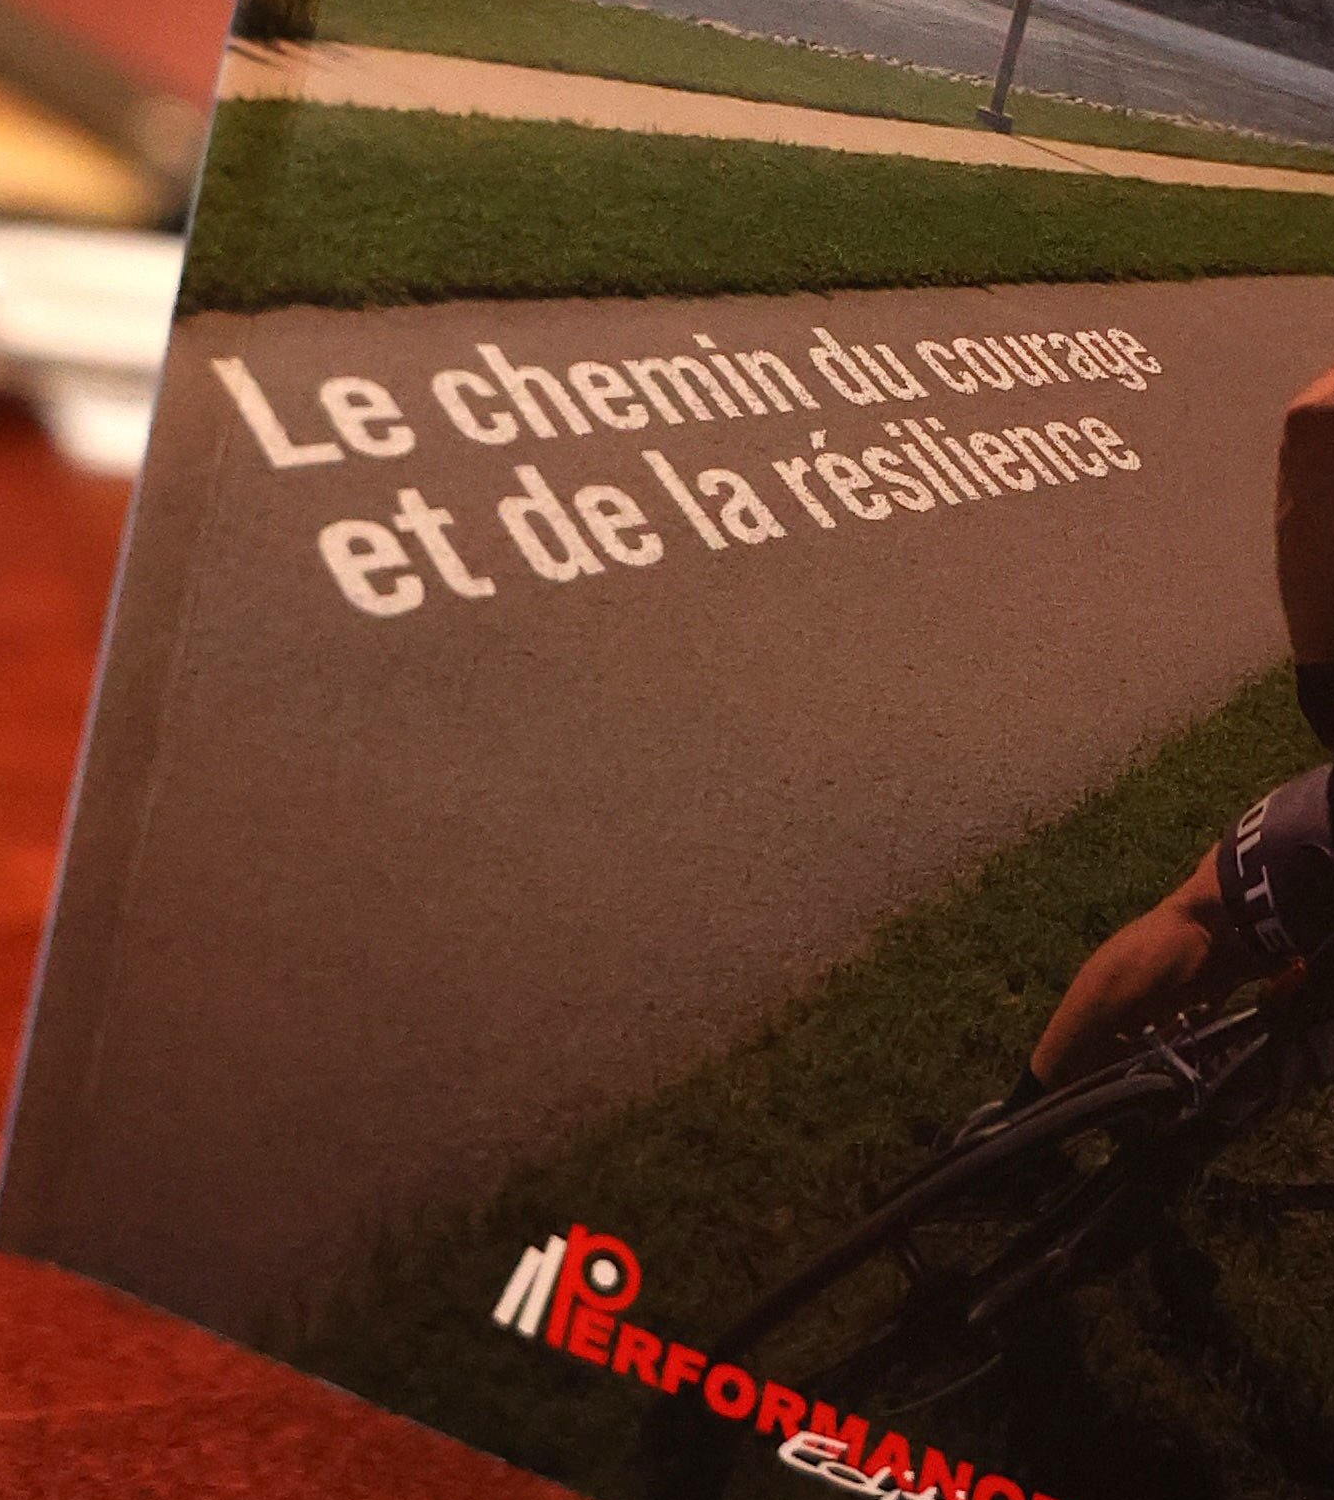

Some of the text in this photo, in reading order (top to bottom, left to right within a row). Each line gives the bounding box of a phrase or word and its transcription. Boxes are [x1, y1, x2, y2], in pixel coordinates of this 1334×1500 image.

[210, 321, 1164, 471] Le chemin du courage
[316, 410, 1143, 619] et de la résilience
